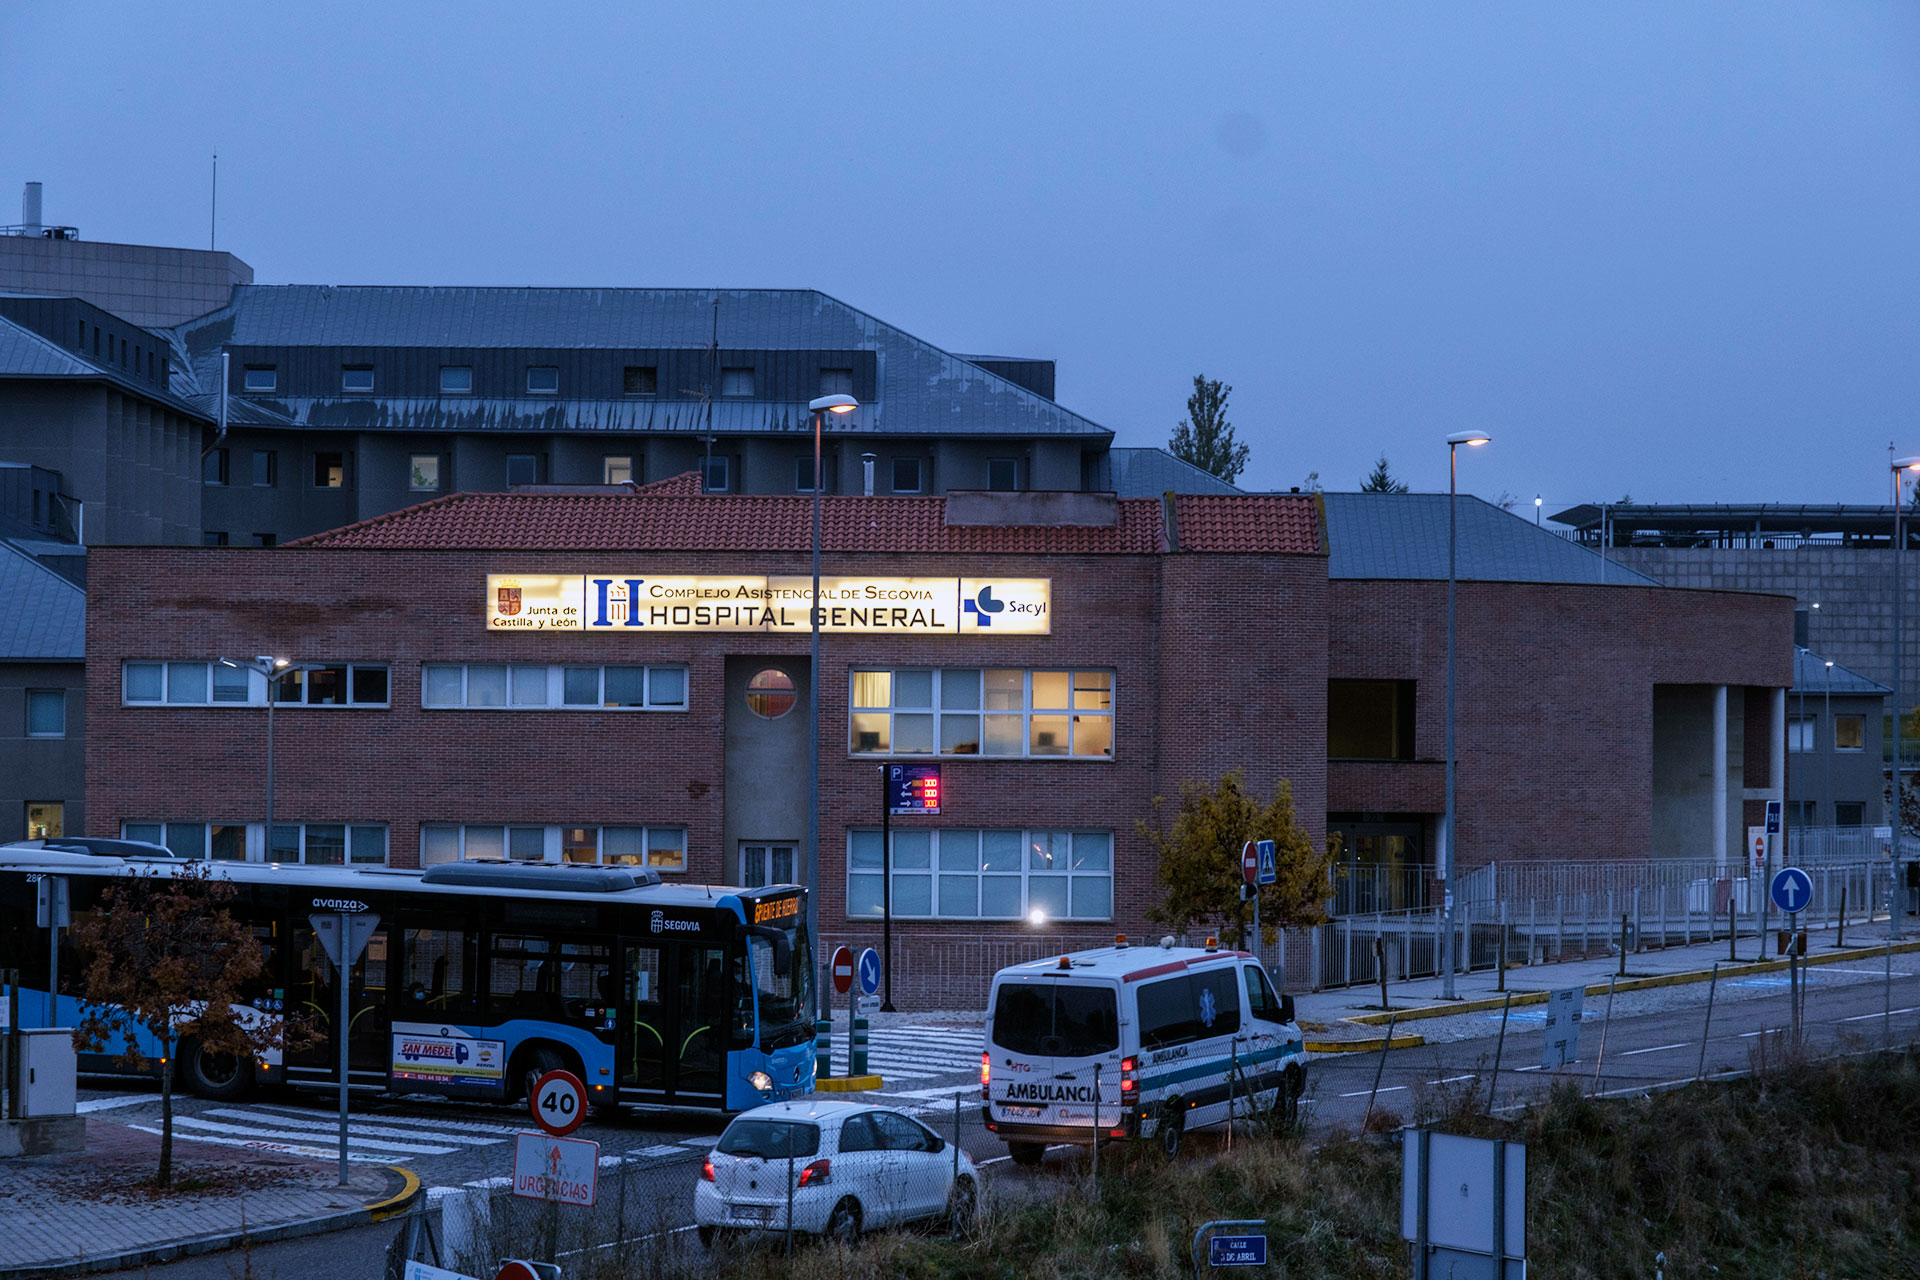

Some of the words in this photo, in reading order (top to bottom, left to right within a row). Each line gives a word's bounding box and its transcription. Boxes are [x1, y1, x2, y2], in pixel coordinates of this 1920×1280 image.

[649, 584, 730, 599] COMPLEJO
[735, 585, 838, 600] ASISTENCAL
[841, 588, 860, 600] DE
[864, 585, 933, 601] SEGOVIA
[526, 605, 559, 617] Junta
[563, 605, 577, 616] de
[1009, 600, 1047, 617] Sacyl
[493, 616, 533, 627] Castilla
[538, 619, 545, 629] y
[551, 616, 577, 628] León
[650, 605, 795, 627] HOSPITAL
[810, 607, 945, 628] GENERAL
[893, 768, 901, 779] P
[312, 898, 357, 909] avanza
[664, 920, 701, 932] SEGOVIA
[402, 1043, 421, 1054] SAN
[422, 1045, 454, 1057] MEDEL
[1011, 1063, 1031, 1073] HTG
[1006, 1083, 1102, 1102] AMBULANCIA
[541, 1091, 575, 1114] 40
[1230, 1241, 1247, 1249] CALLE
[1226, 1253, 1235, 1261] DE
[1236, 1252, 1257, 1261] ABRIL
